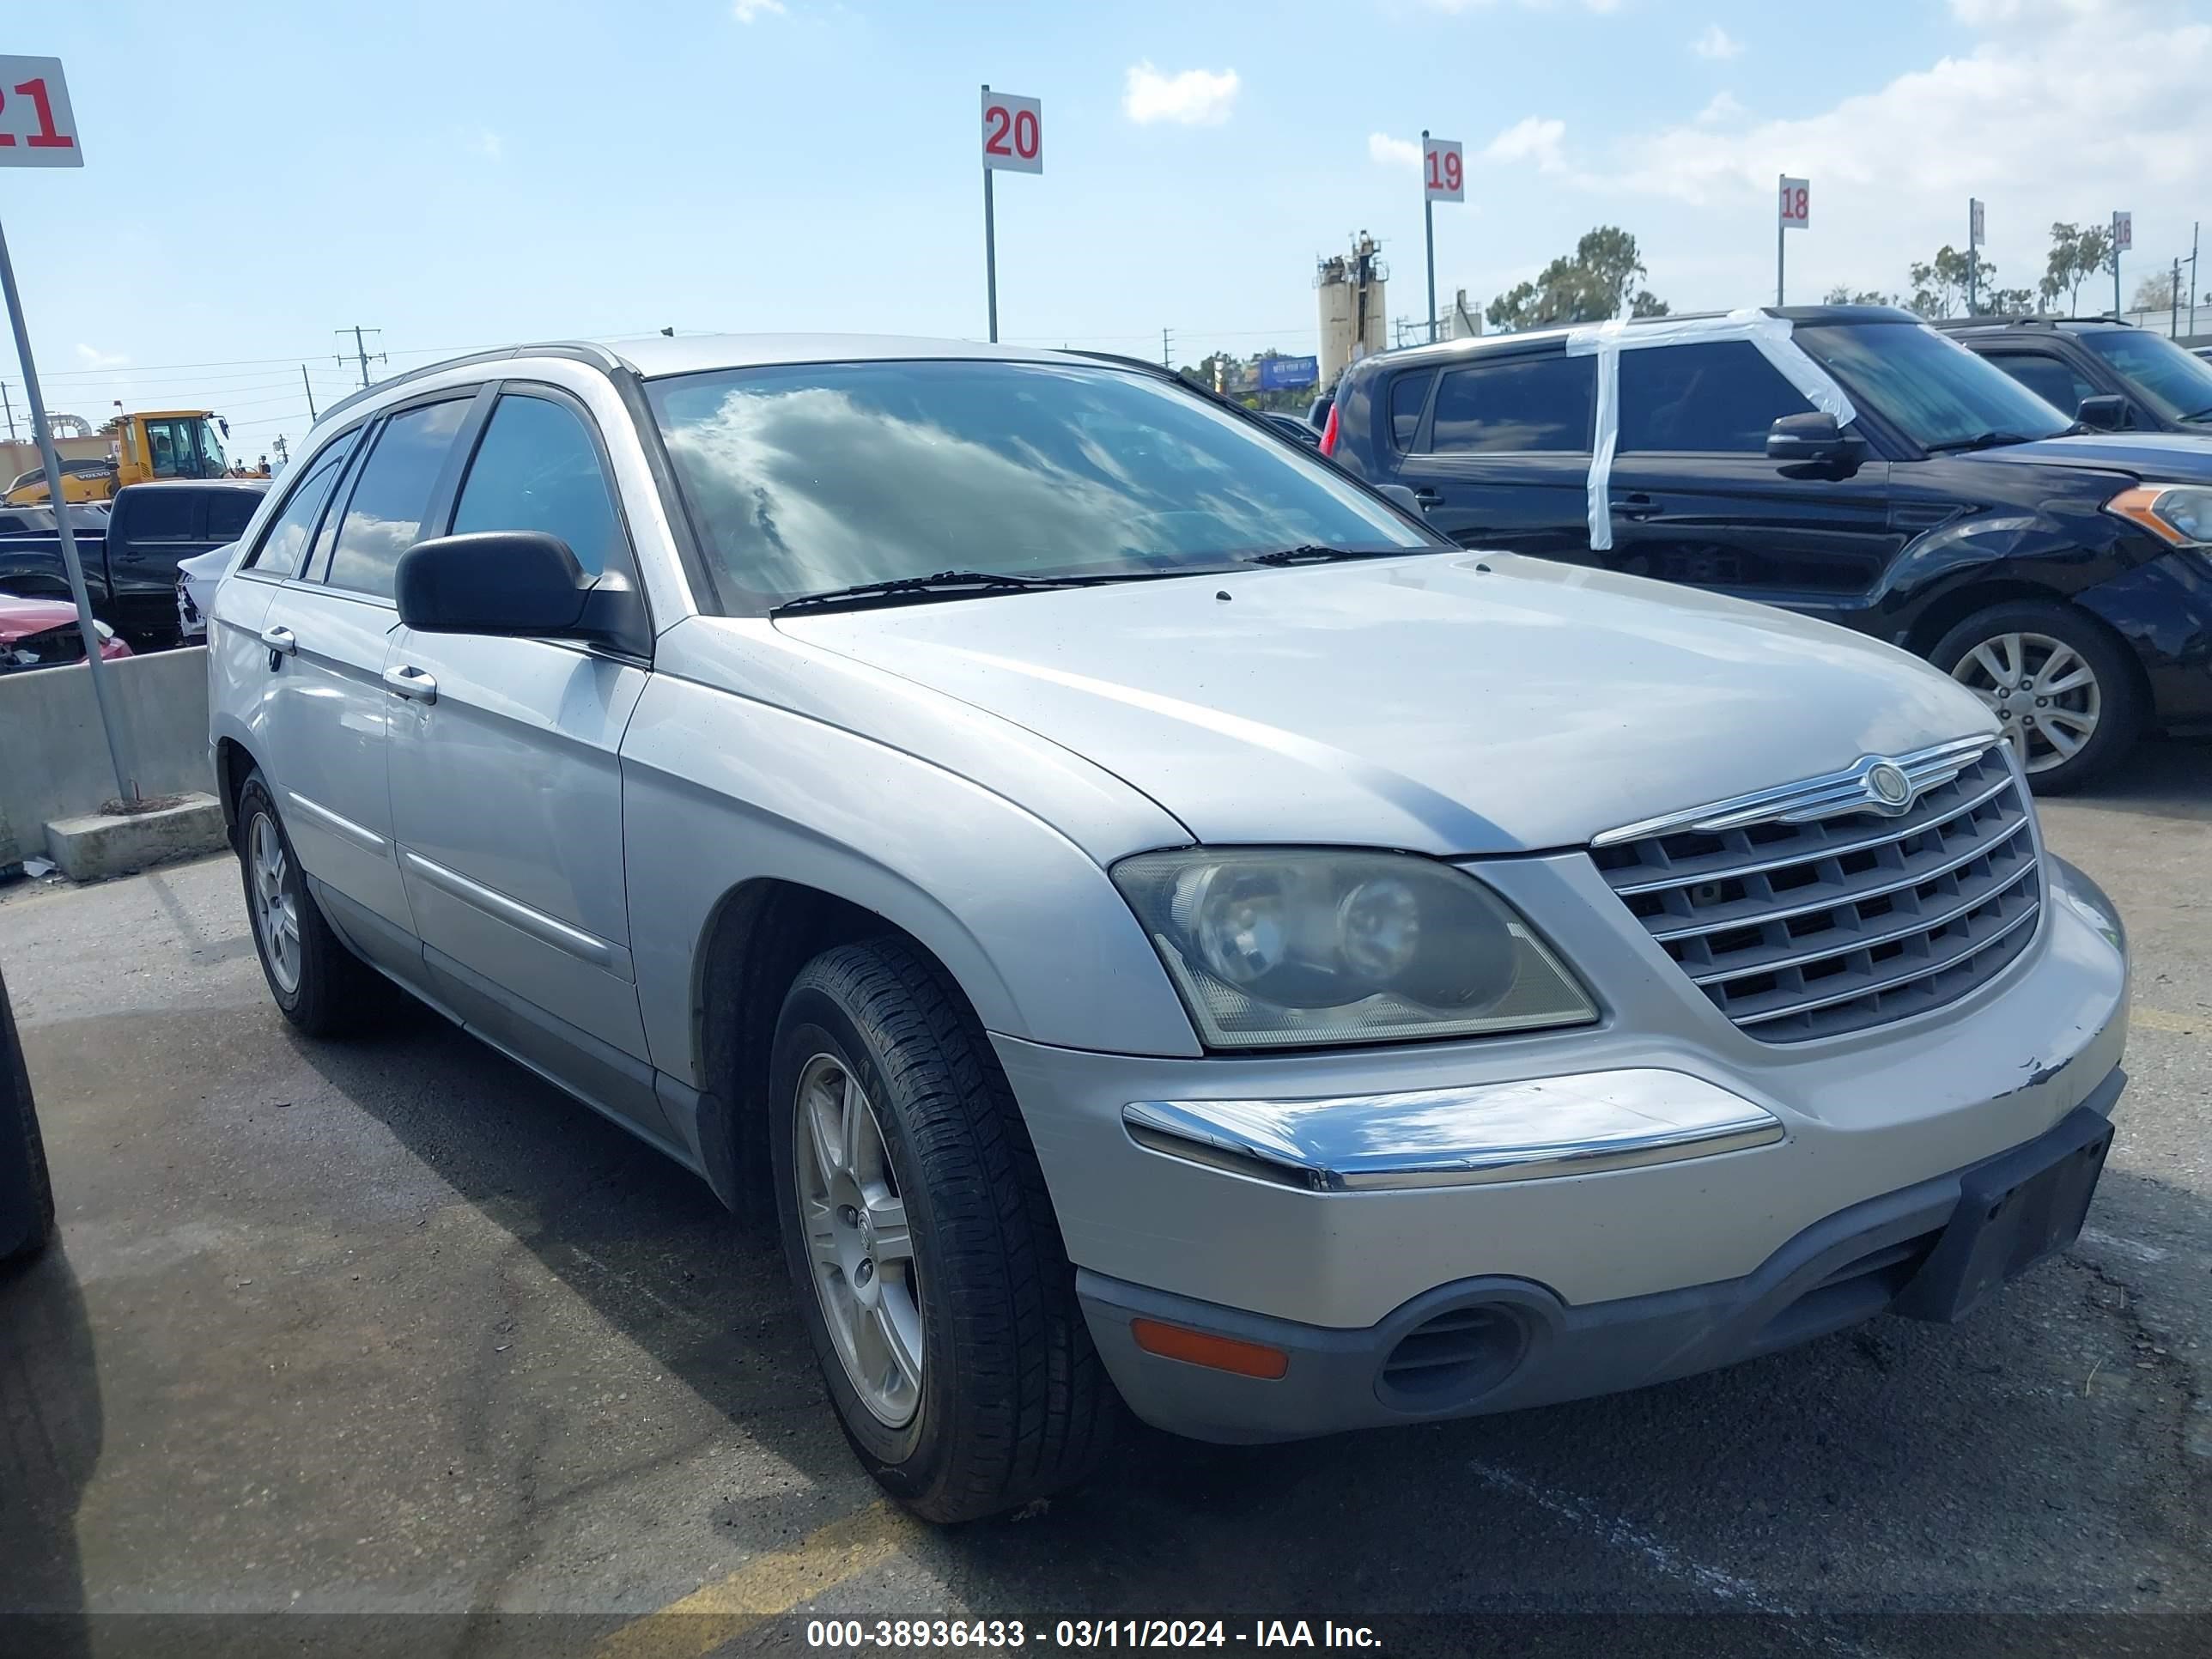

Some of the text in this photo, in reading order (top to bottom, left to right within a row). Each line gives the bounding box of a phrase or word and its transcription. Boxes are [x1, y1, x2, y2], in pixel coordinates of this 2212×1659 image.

[986, 106, 1039, 160] 20
[1427, 150, 1462, 191] 19
[1782, 186, 1808, 220] 18
[2117, 219, 2131, 244] 16
